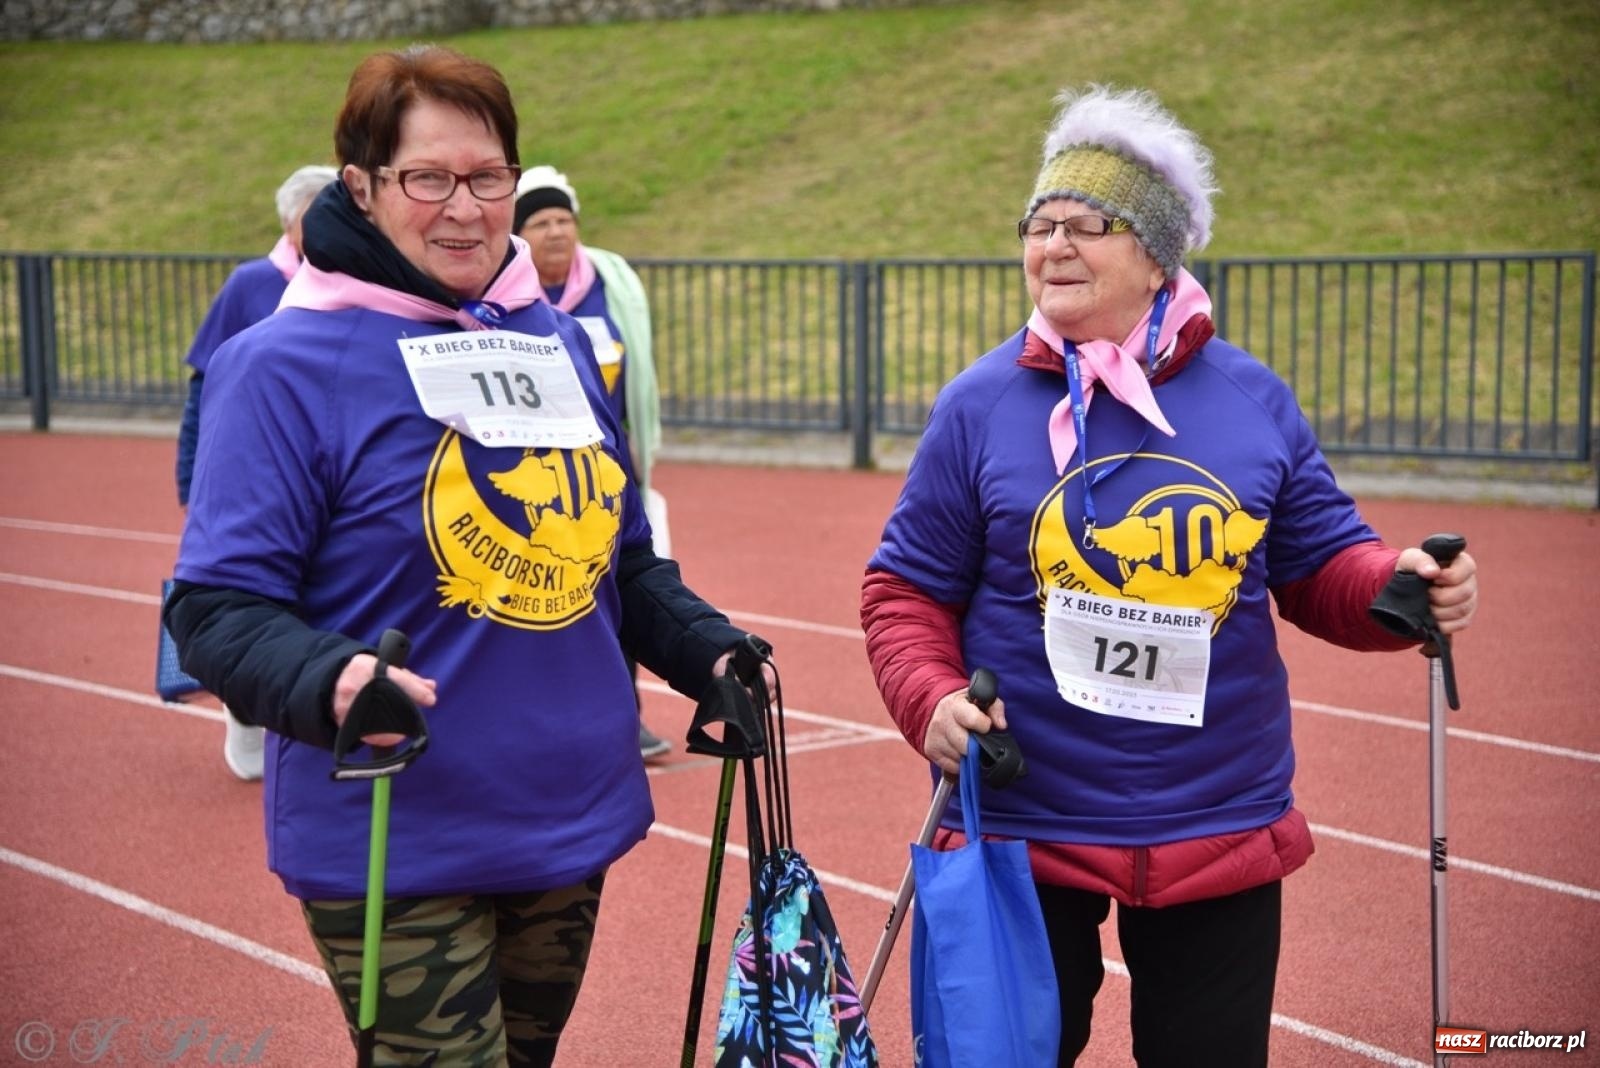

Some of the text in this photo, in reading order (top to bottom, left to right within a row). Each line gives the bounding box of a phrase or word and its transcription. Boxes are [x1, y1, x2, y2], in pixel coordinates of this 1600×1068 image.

[418, 338, 553, 356] X BIEG BEZ BARIER
[470, 370, 542, 409] 113
[448, 512, 565, 591] RACIBORSKI
[1146, 503, 1226, 576] 10
[510, 593, 540, 614] BIEG
[545, 597, 567, 614] BEZ
[1061, 596, 1073, 609] X
[1077, 599, 1113, 616] BIEG
[1118, 606, 1147, 622] BEZ
[1152, 612, 1201, 628] BARIER
[1094, 636, 1159, 681] 121
